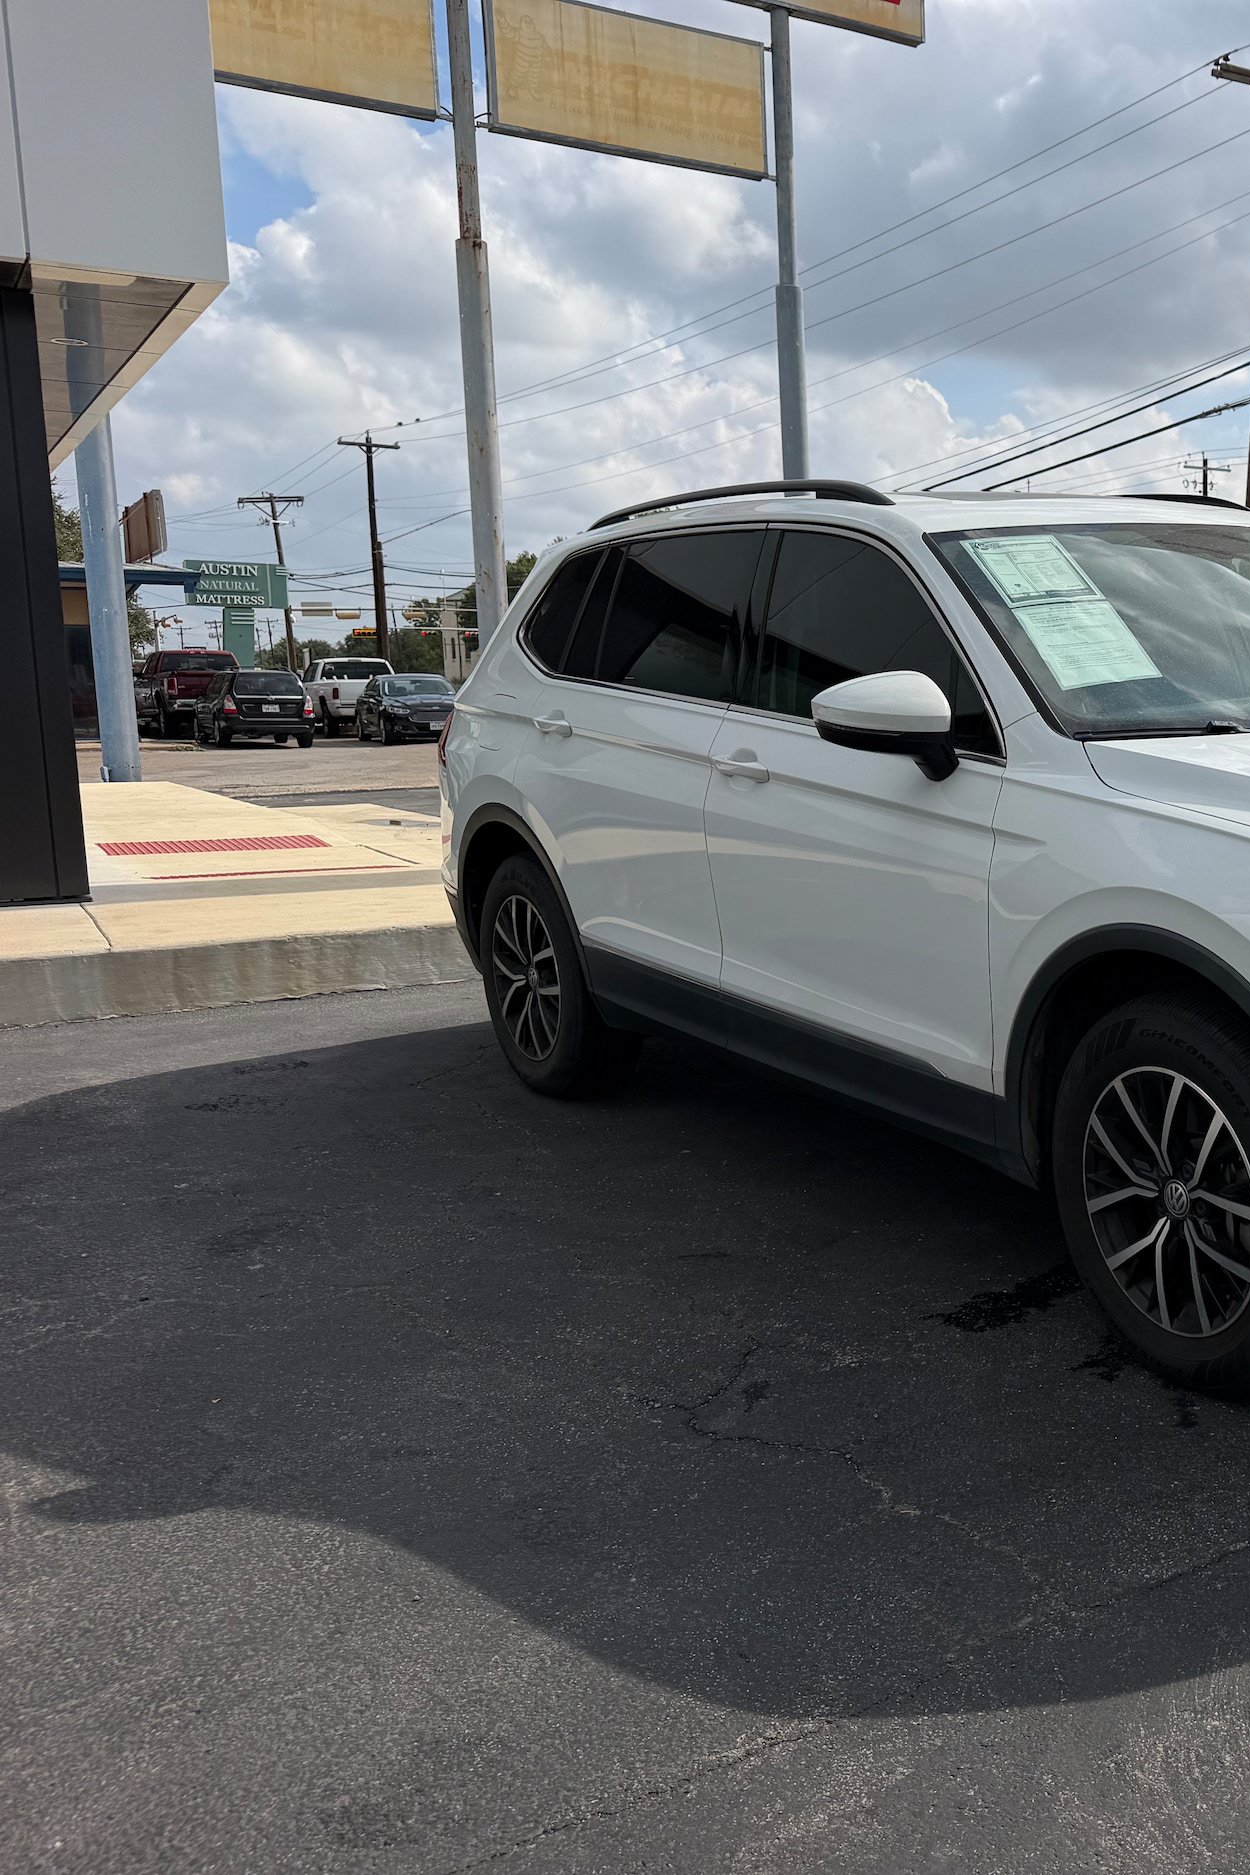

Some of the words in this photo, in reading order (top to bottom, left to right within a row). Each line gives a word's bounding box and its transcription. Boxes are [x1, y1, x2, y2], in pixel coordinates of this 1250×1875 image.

[199, 563, 258, 576] AUSTIN
[200, 580, 258, 591] NATURAL
[196, 594, 265, 605] MATTRESS
